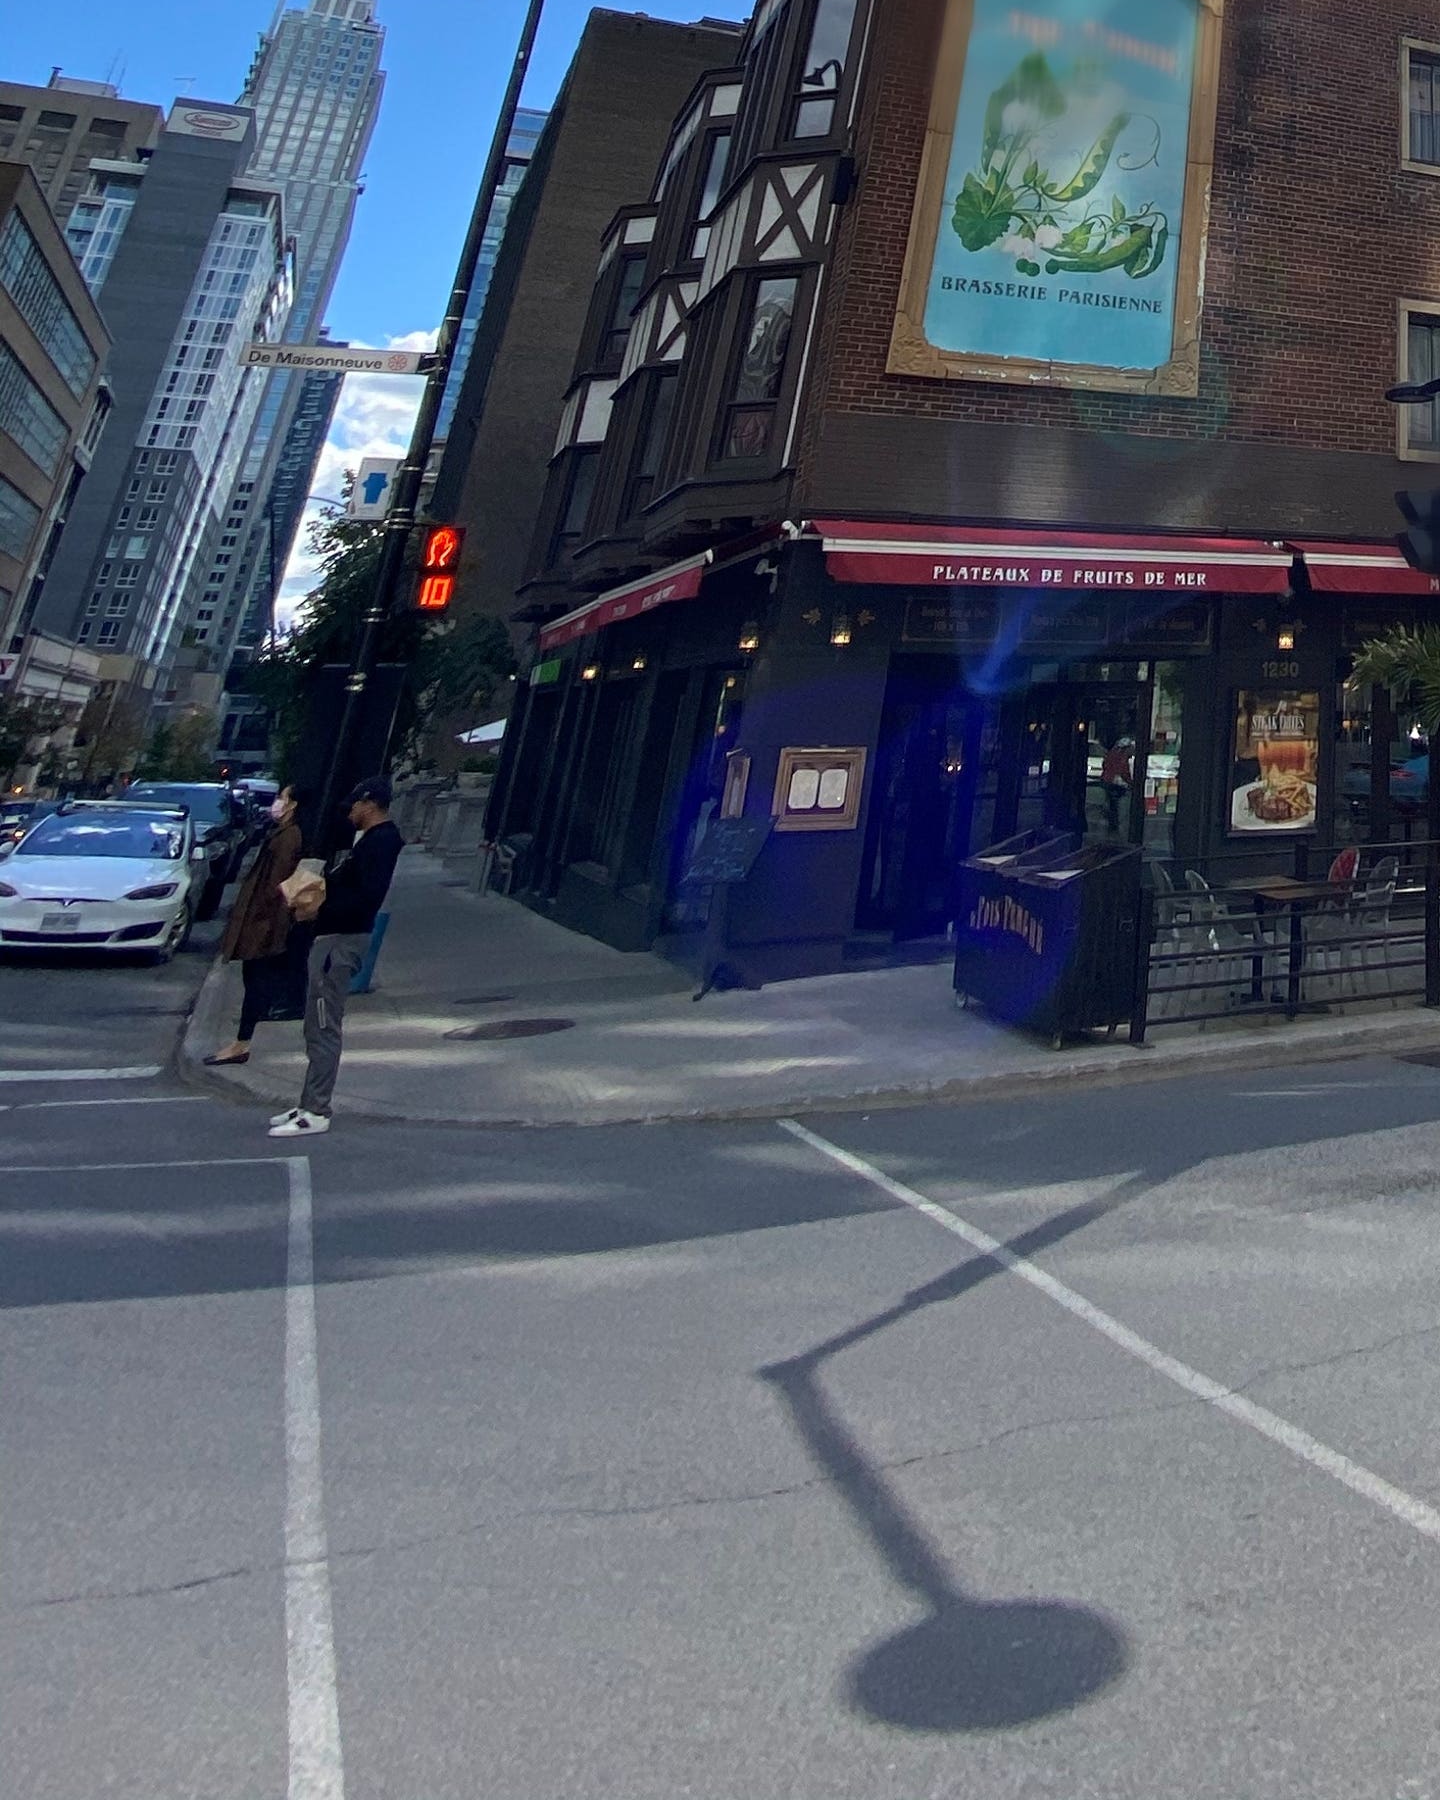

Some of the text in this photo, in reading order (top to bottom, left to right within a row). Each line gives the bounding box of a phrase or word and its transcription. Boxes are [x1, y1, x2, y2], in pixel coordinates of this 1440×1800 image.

[941, 276, 1162, 314] BRASSERIE PARISIENNE
[248, 350, 383, 370] De Maisonneuve
[933, 565, 1206, 586] PLATEAUX DE FRUITS DE MER
[420, 576, 452, 605] 10
[1262, 661, 1299, 678] 1230
